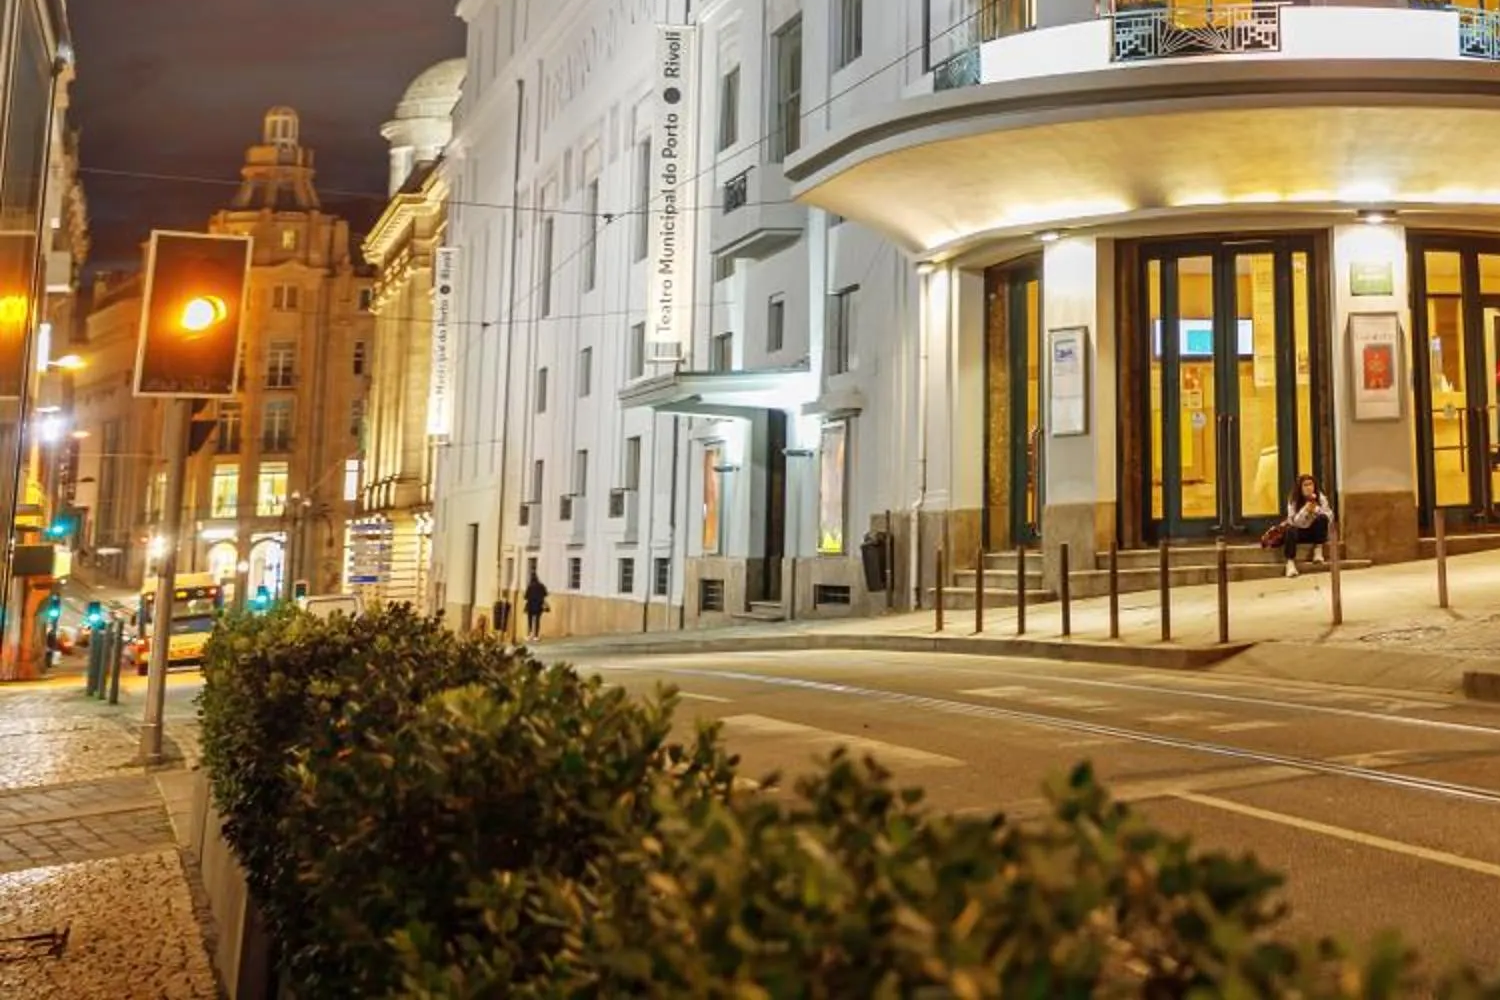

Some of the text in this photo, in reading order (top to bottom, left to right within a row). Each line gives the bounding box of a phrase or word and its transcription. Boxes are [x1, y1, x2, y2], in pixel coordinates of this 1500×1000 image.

[655, 31, 682, 336] Teatro Municipal do Porto Rivoli
